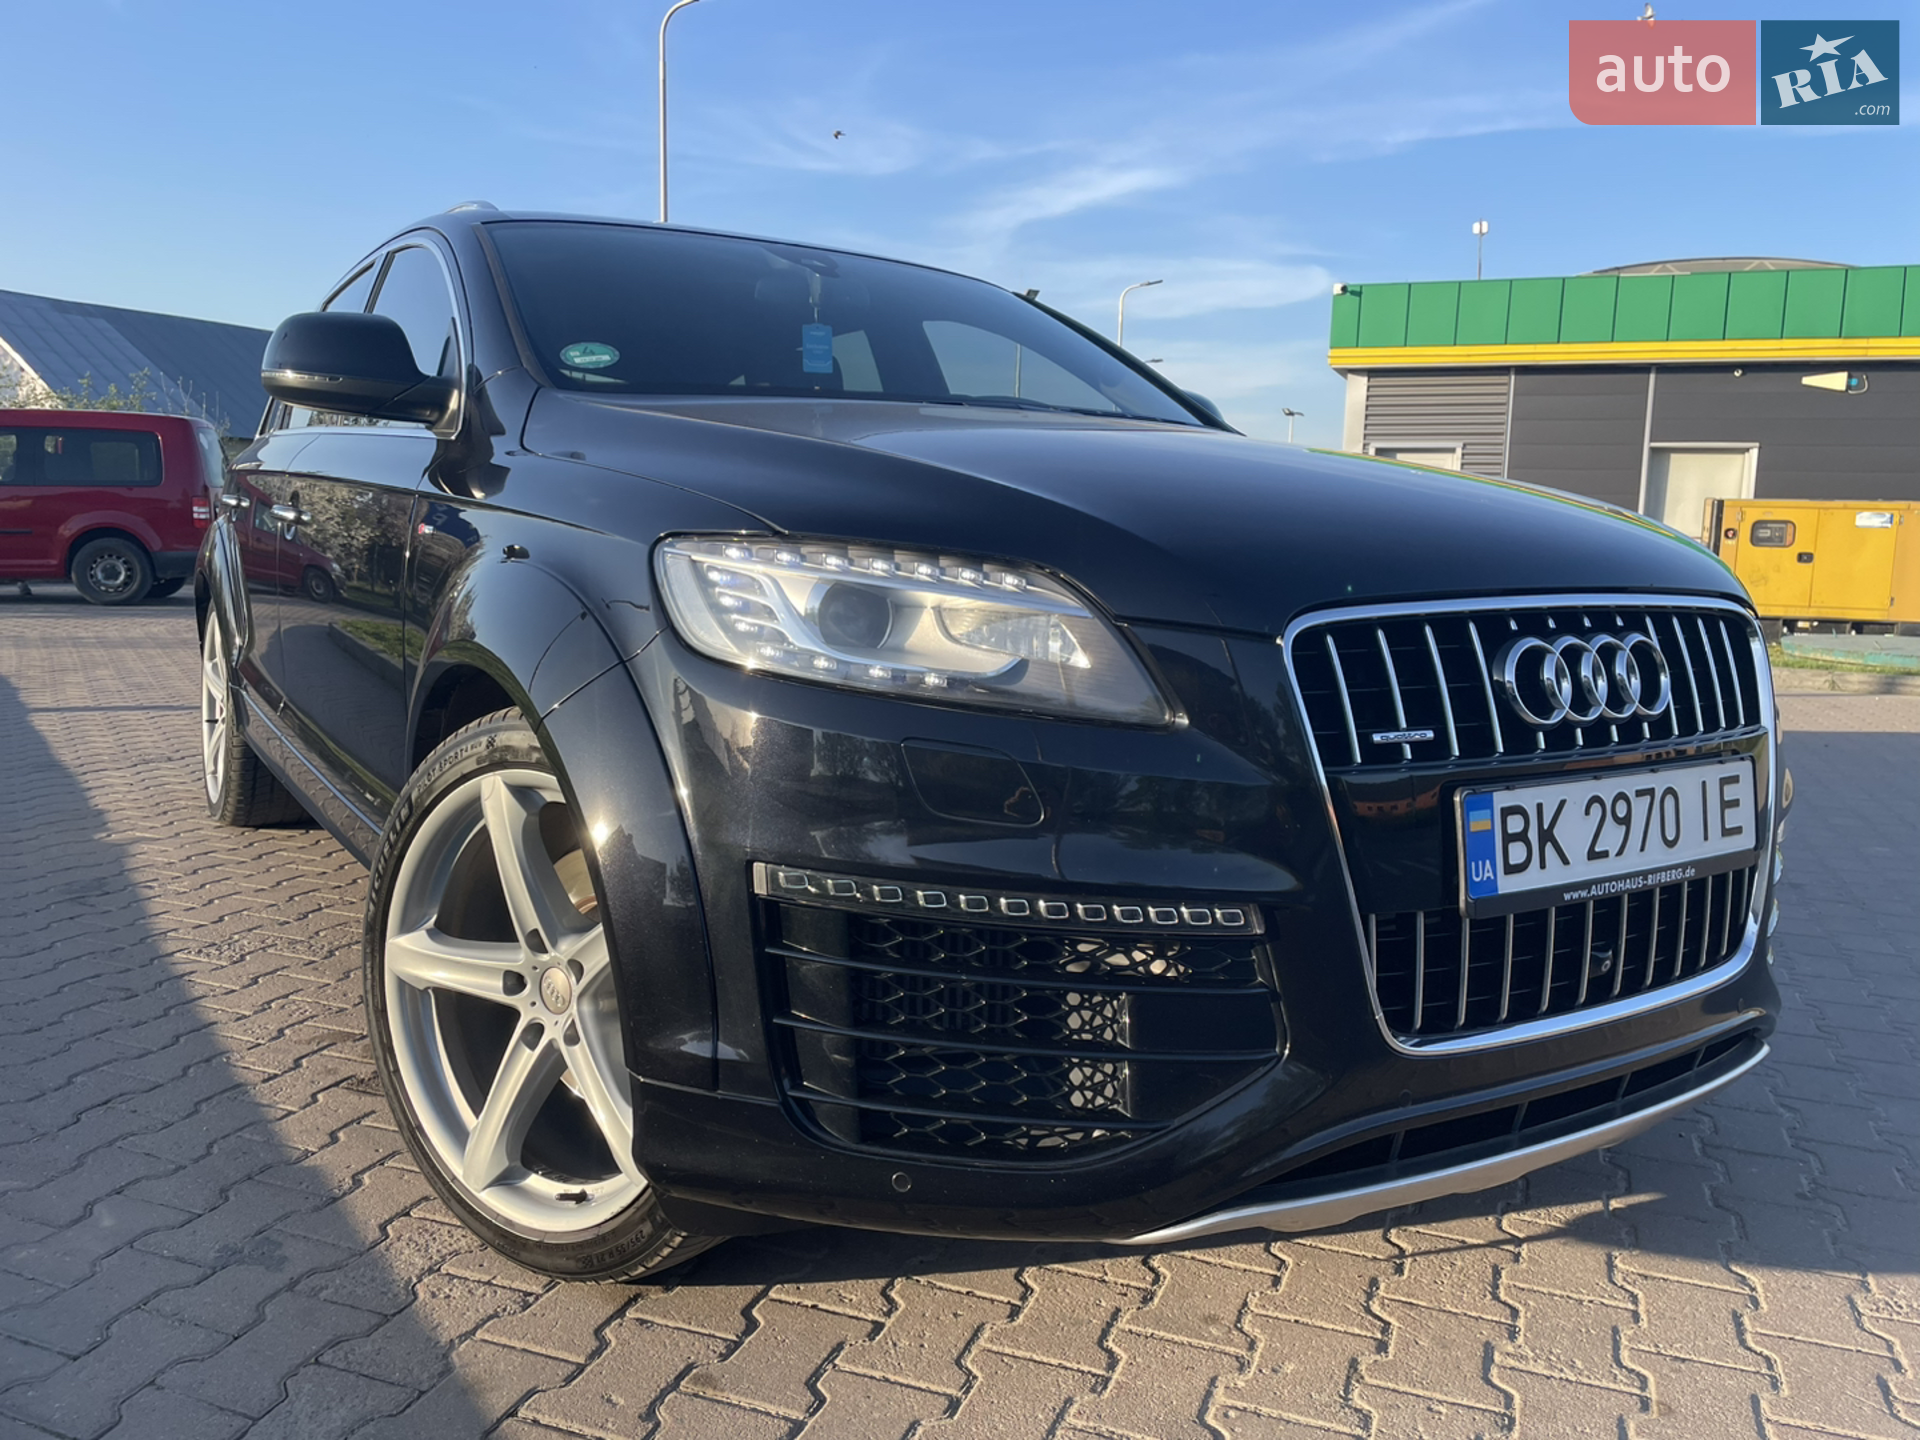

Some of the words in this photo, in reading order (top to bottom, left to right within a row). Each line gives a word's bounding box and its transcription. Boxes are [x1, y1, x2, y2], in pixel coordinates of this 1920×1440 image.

[1380, 732, 1428, 742] quattro
[439, 748, 465, 774] SPORT
[1500, 798, 1572, 876] BK
[1584, 785, 1681, 862] 2970
[1700, 774, 1744, 842] IE
[367, 801, 411, 922] MICHELIN
[1471, 859, 1495, 882] UA
[1563, 865, 1696, 901] www.AUTOHAUS-RIFBERG.de
